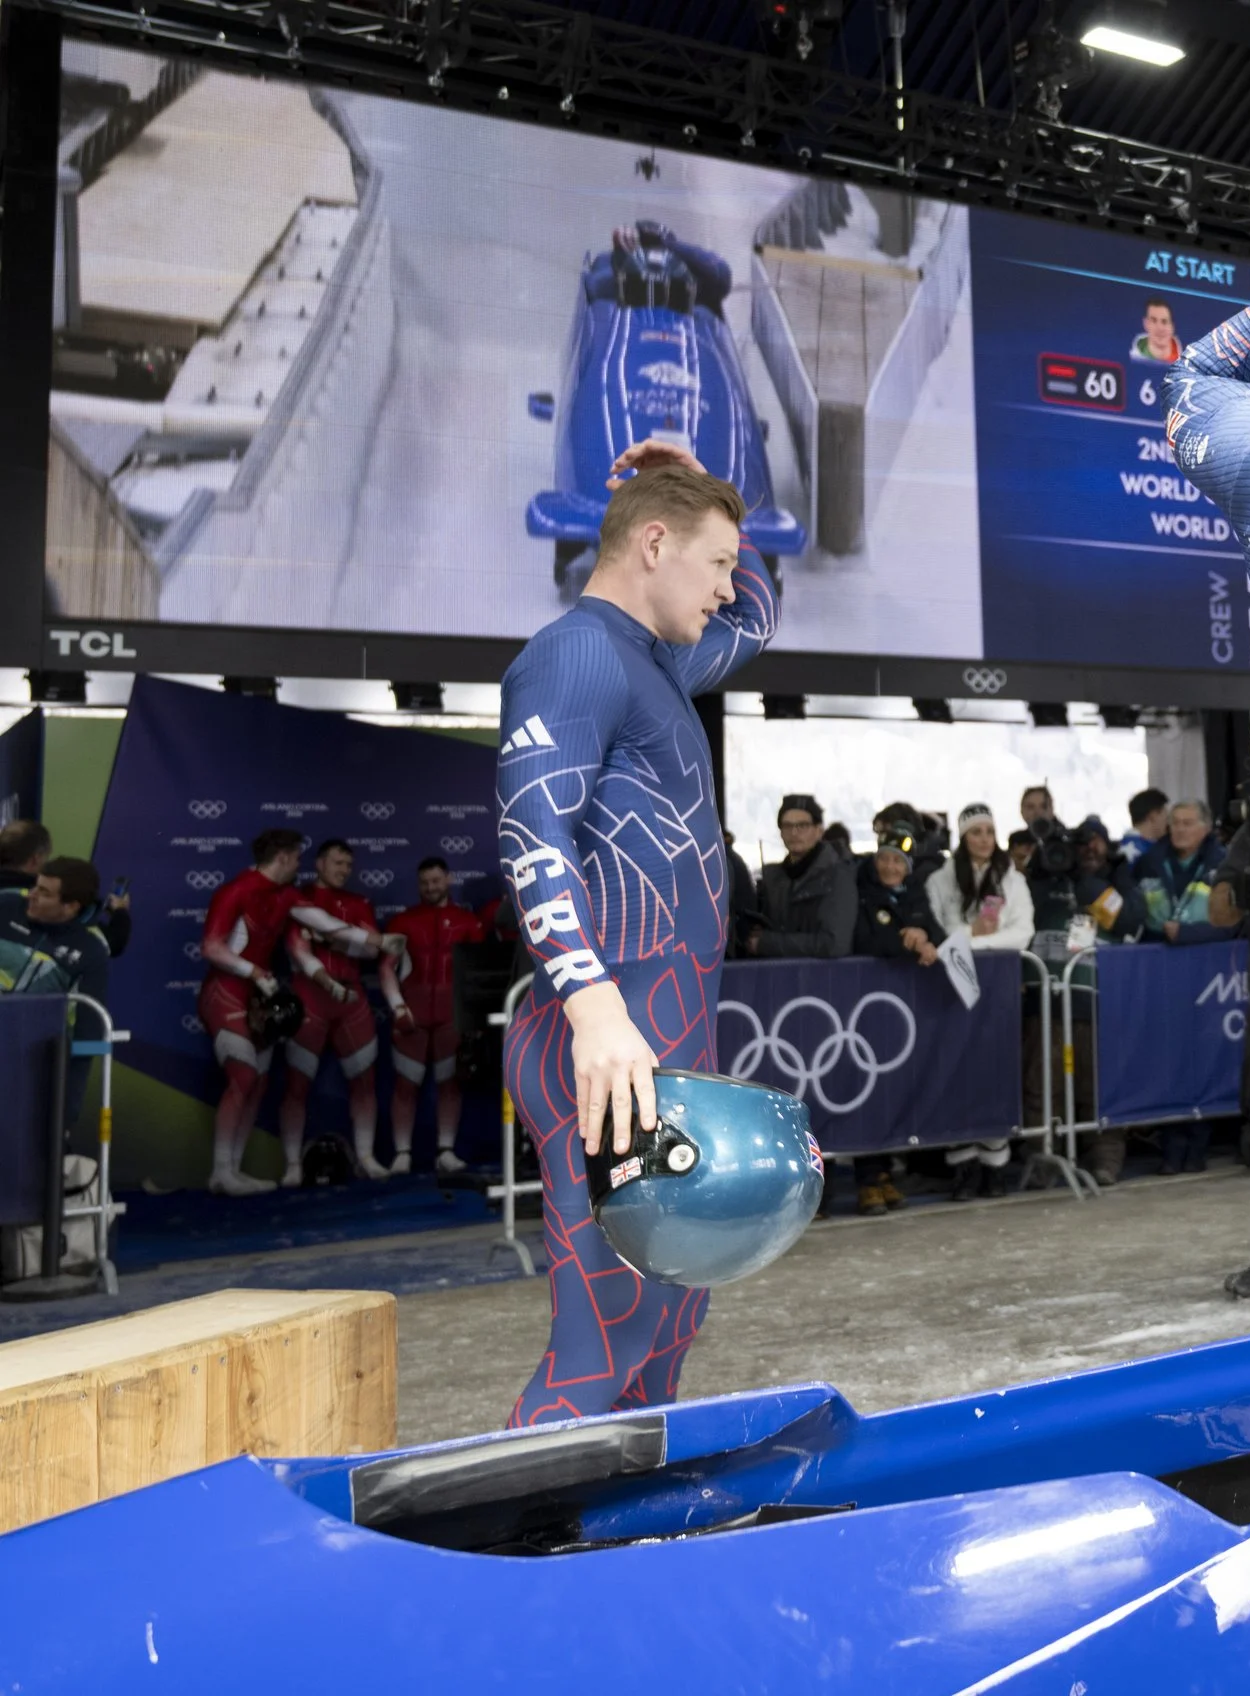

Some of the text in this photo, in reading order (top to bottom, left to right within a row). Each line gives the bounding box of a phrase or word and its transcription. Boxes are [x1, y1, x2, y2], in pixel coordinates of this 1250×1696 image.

[1145, 251, 1235, 285] AT START
[1084, 371, 1117, 400] 60
[1120, 472, 1200, 502] WORLD
[1151, 513, 1230, 541] WORLD
[1208, 570, 1233, 664] CREW
[49, 630, 137, 658] TCL
[512, 847, 606, 992] GBR
